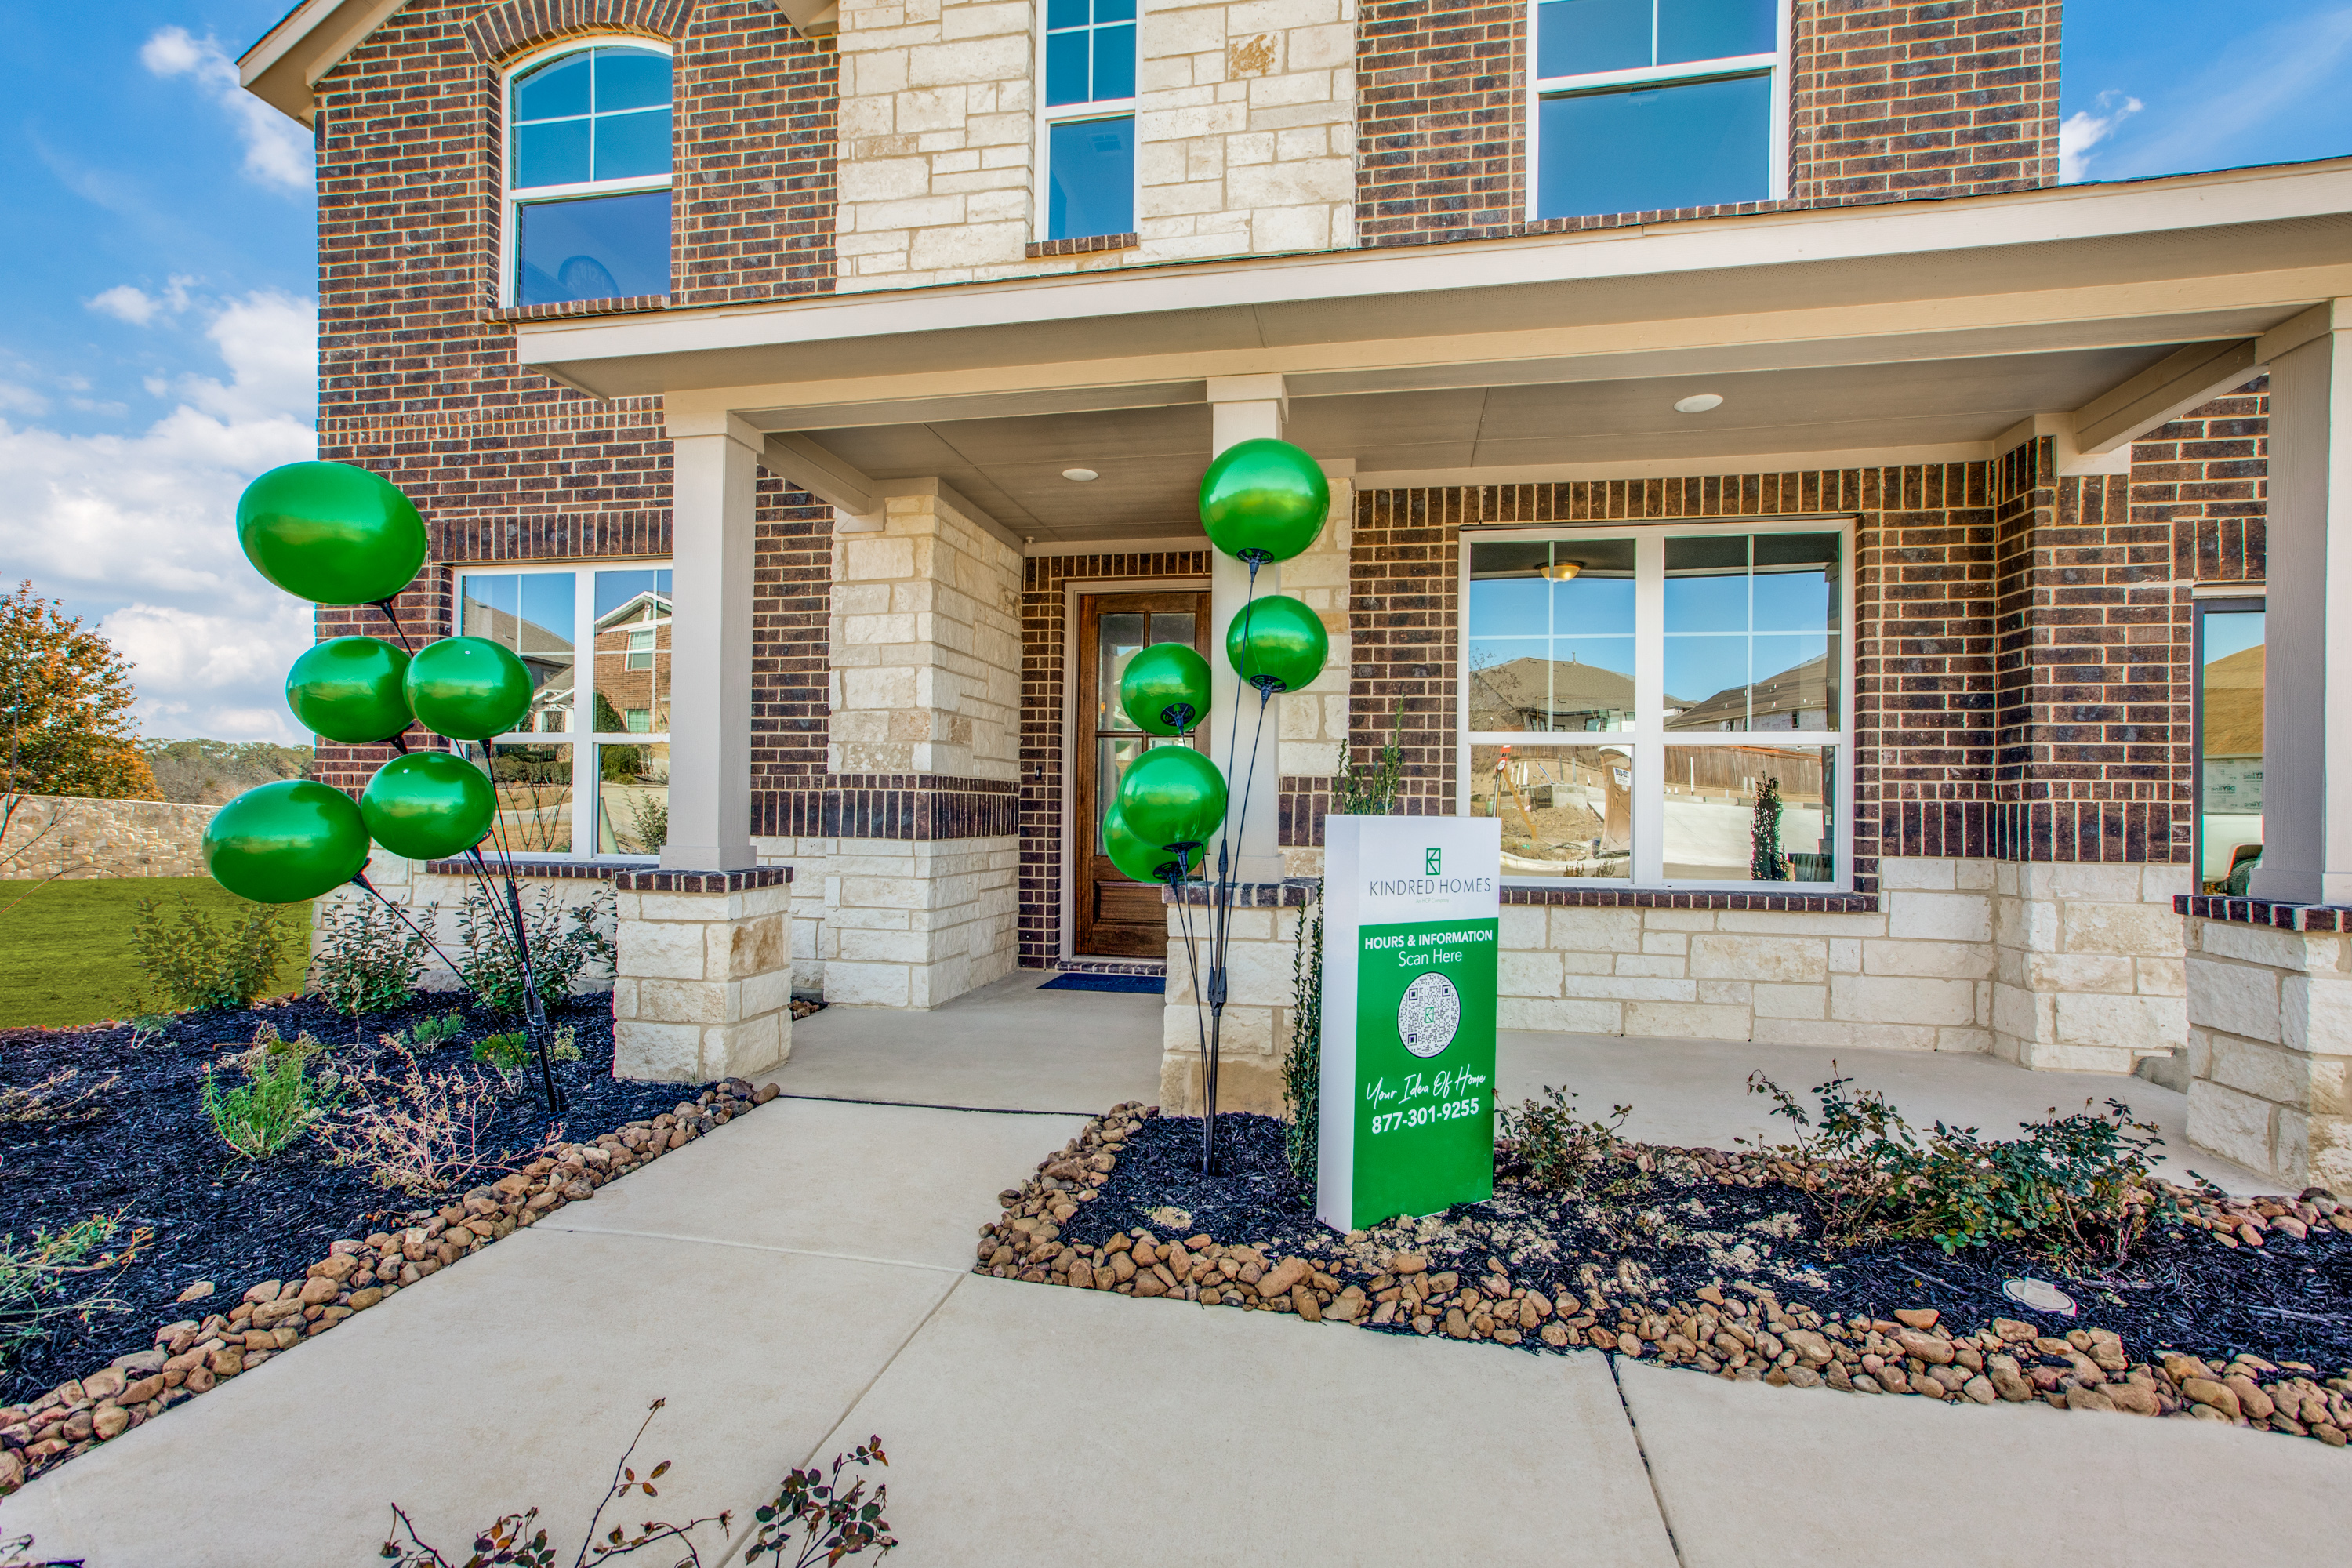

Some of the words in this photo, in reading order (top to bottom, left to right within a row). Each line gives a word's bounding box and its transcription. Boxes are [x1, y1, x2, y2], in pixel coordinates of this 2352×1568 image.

[1370, 879, 1435, 896] KINDRED
[1439, 877, 1491, 894] HOMES
[1365, 935, 1405, 949] HOURS
[1407, 935, 1416, 946] &
[1418, 930, 1493, 946] INFORMATION
[1398, 951, 1428, 967] Scan
[1433, 949, 1462, 964] Here
[1366, 1077, 1398, 1109] Your
[1398, 1073, 1429, 1105] Idea
[1432, 1070, 1453, 1098] Of
[1454, 1063, 1486, 1096] Home
[1372, 1098, 1479, 1134] 877-301-9255
